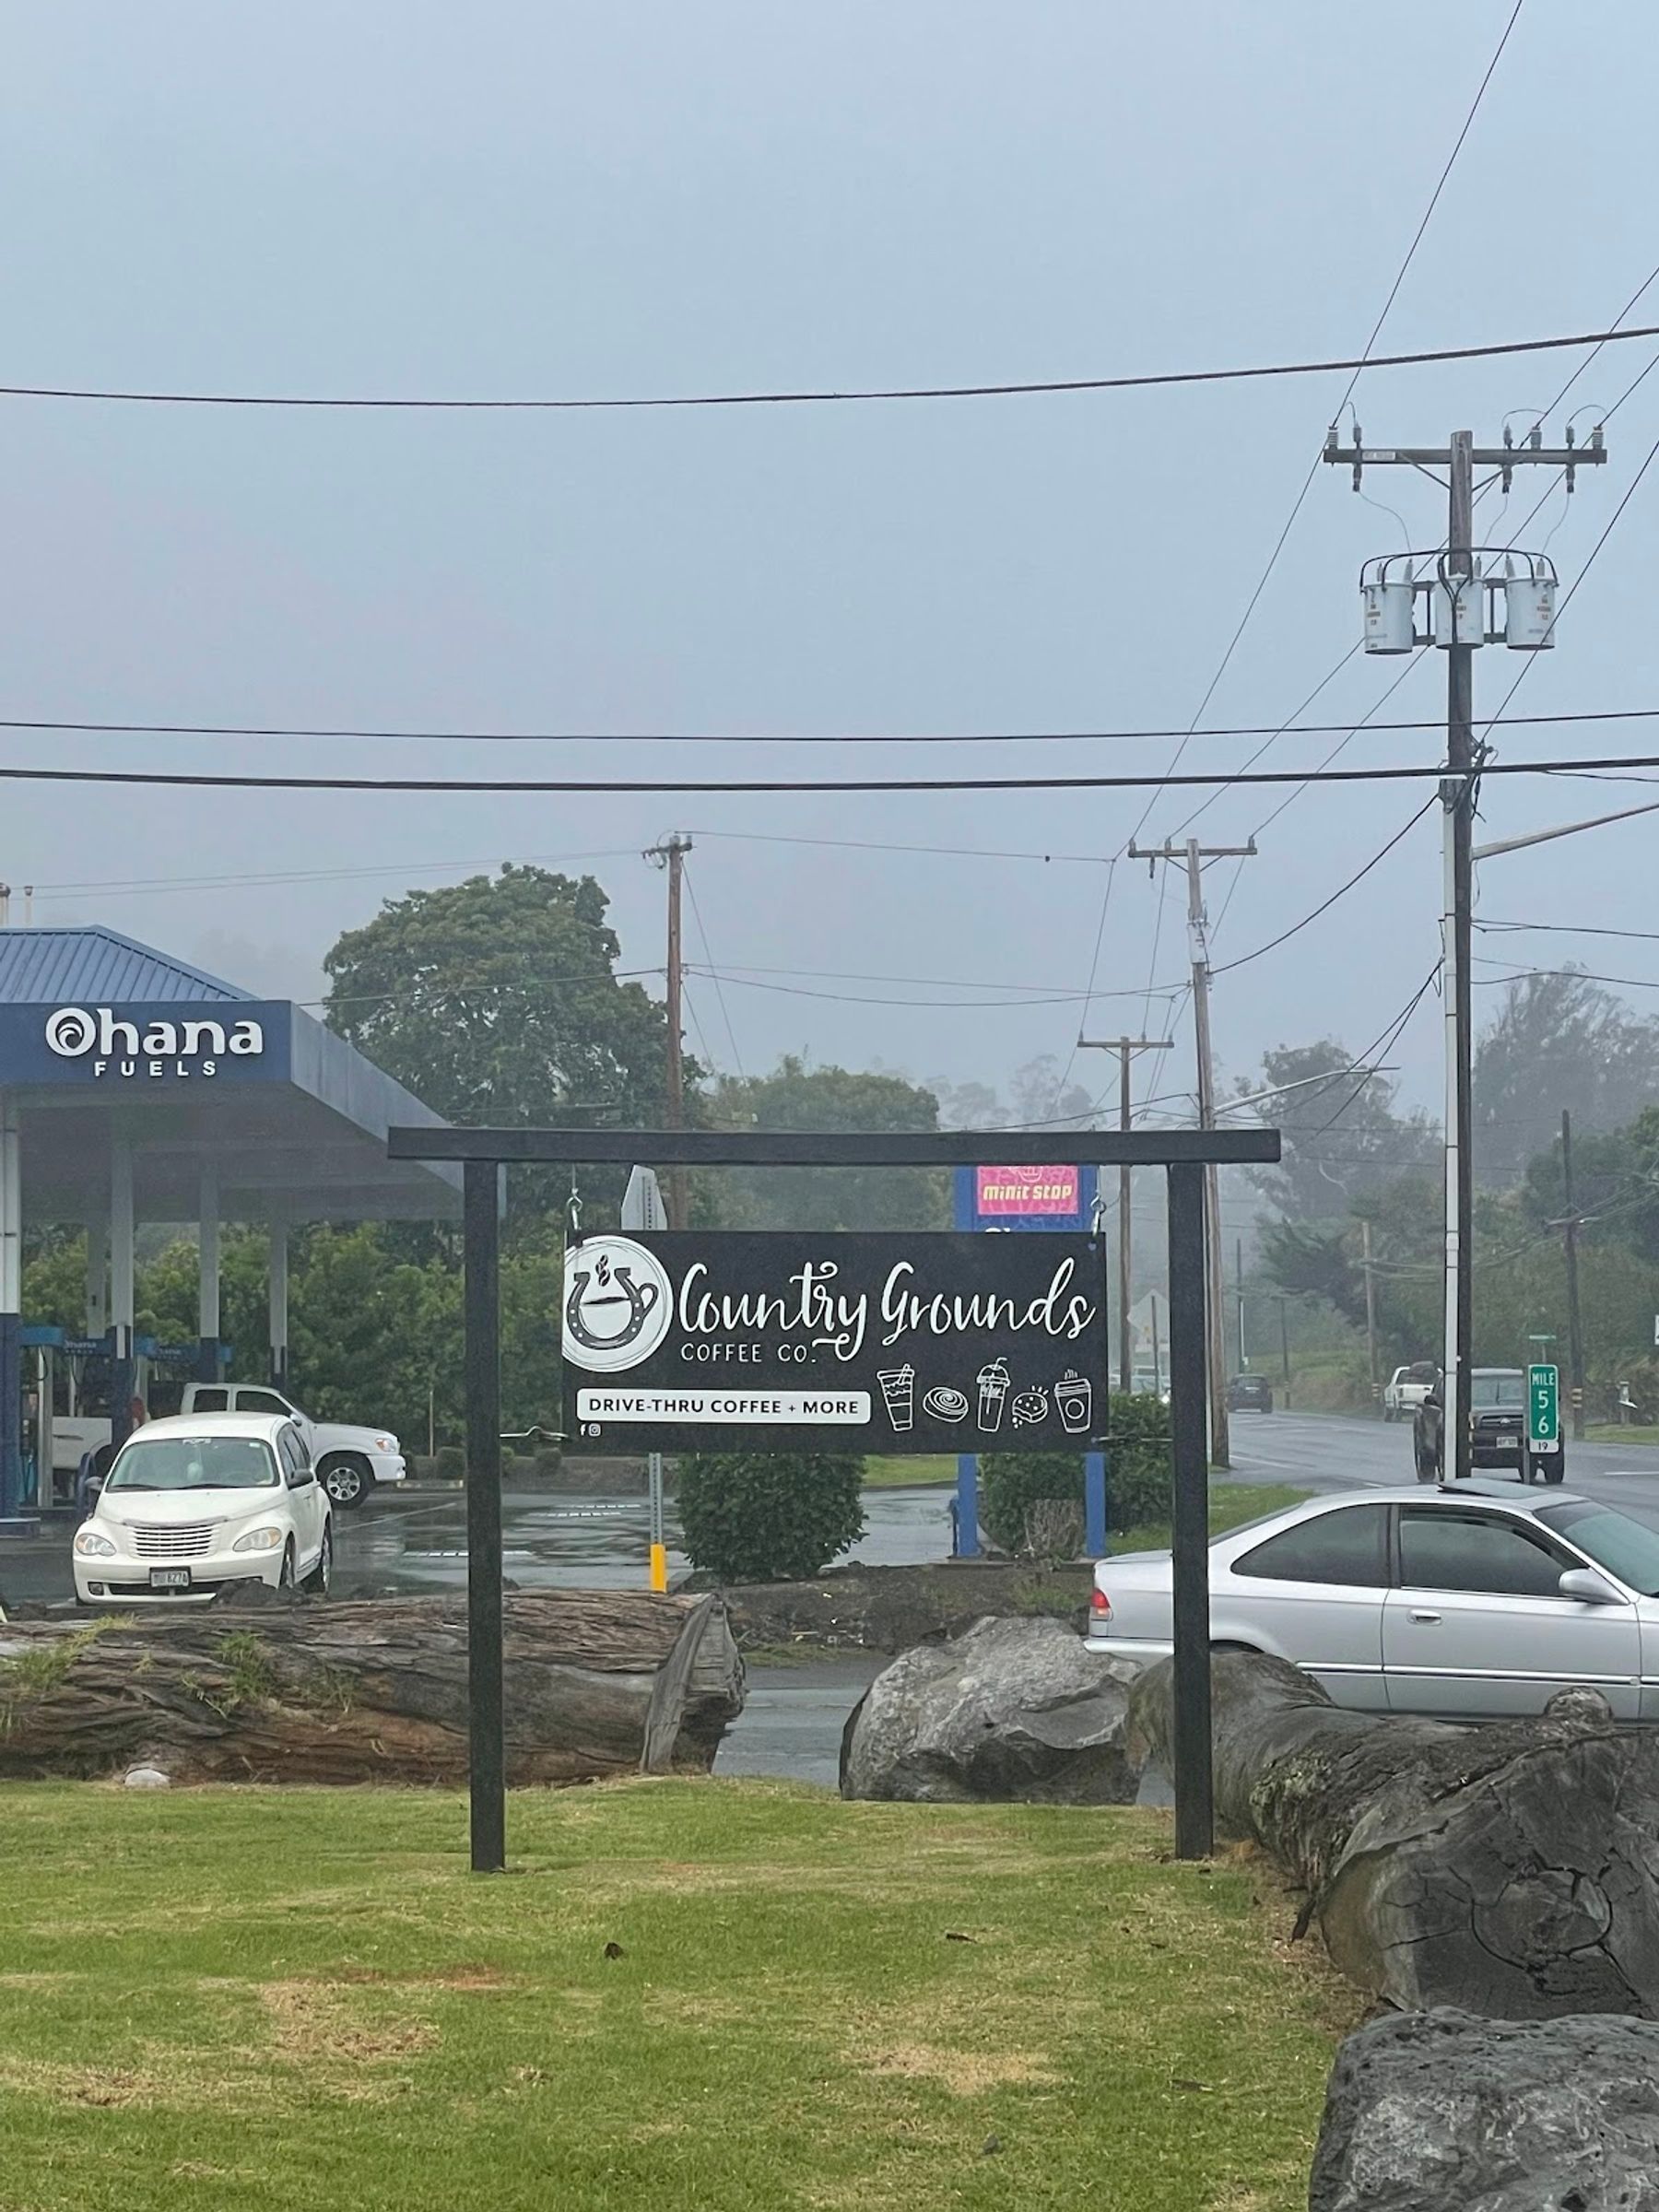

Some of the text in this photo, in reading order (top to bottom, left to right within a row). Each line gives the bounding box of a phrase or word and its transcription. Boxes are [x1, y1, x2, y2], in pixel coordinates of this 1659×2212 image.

[46, 1007, 264, 1056] Ohana
[94, 1061, 216, 1077] FUELS
[679, 1257, 1096, 1360] Country Grounds
[681, 1344, 817, 1362] COFFEE CO.
[1531, 1372, 1555, 1386] MILE
[589, 1398, 704, 1412] DRIVE-THRU
[711, 1400, 782, 1413] COFFEE
[803, 1401, 858, 1414] MORE
[1538, 1441, 1548, 1452] 19
